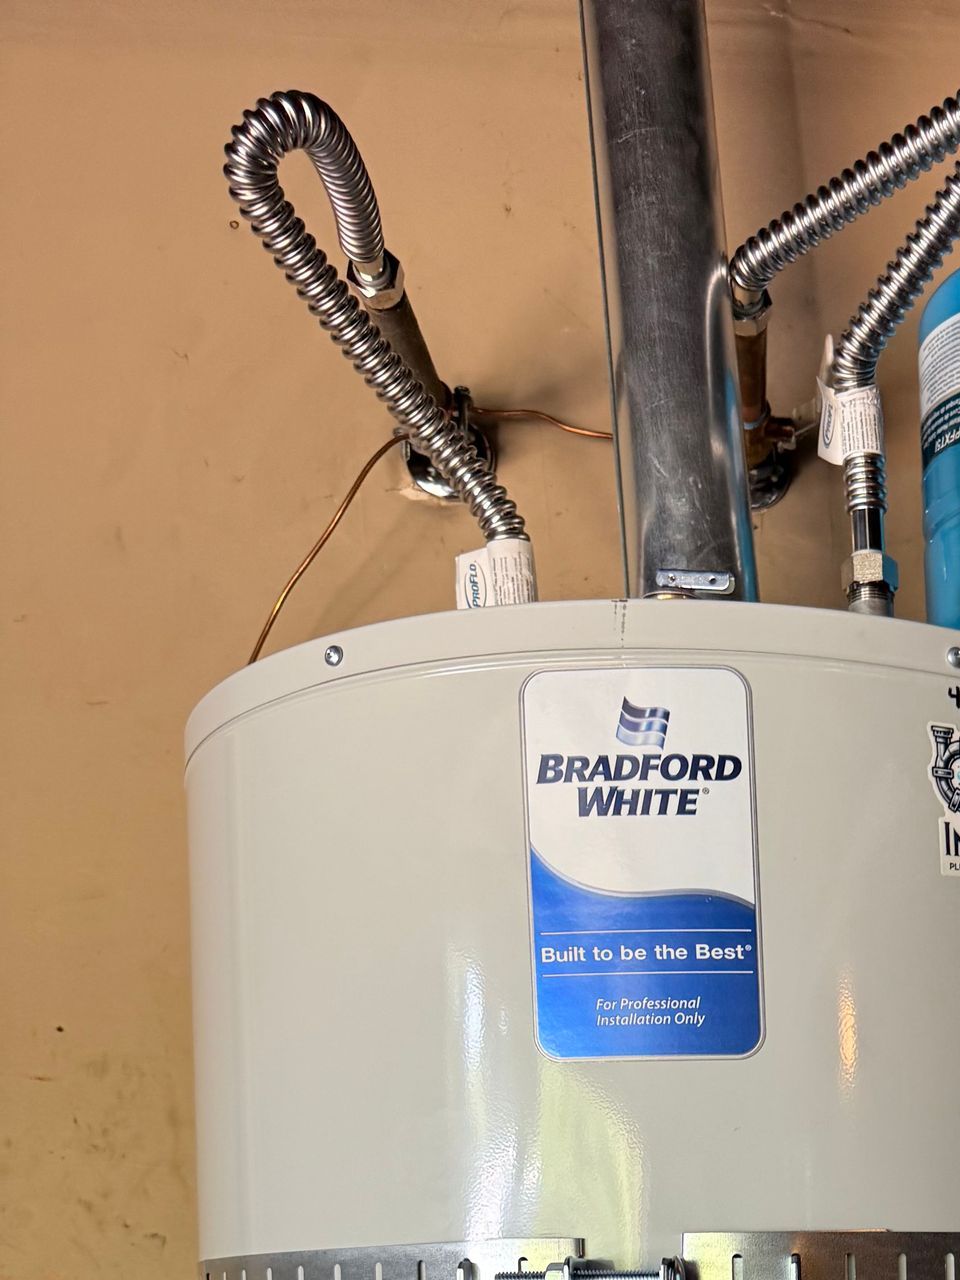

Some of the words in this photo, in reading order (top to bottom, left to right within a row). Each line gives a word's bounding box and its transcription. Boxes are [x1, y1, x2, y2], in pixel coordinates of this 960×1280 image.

[469, 563, 481, 608] PROFLO
[536, 752, 742, 784] BRADFORD
[541, 946, 586, 963] Built
[593, 946, 613, 961] to
[620, 945, 647, 960] be
[654, 944, 688, 960] the
[597, 998, 618, 1011] For
[620, 996, 701, 1010] Professional
[597, 1012, 671, 1026] Installation
[674, 1012, 706, 1028] Only
